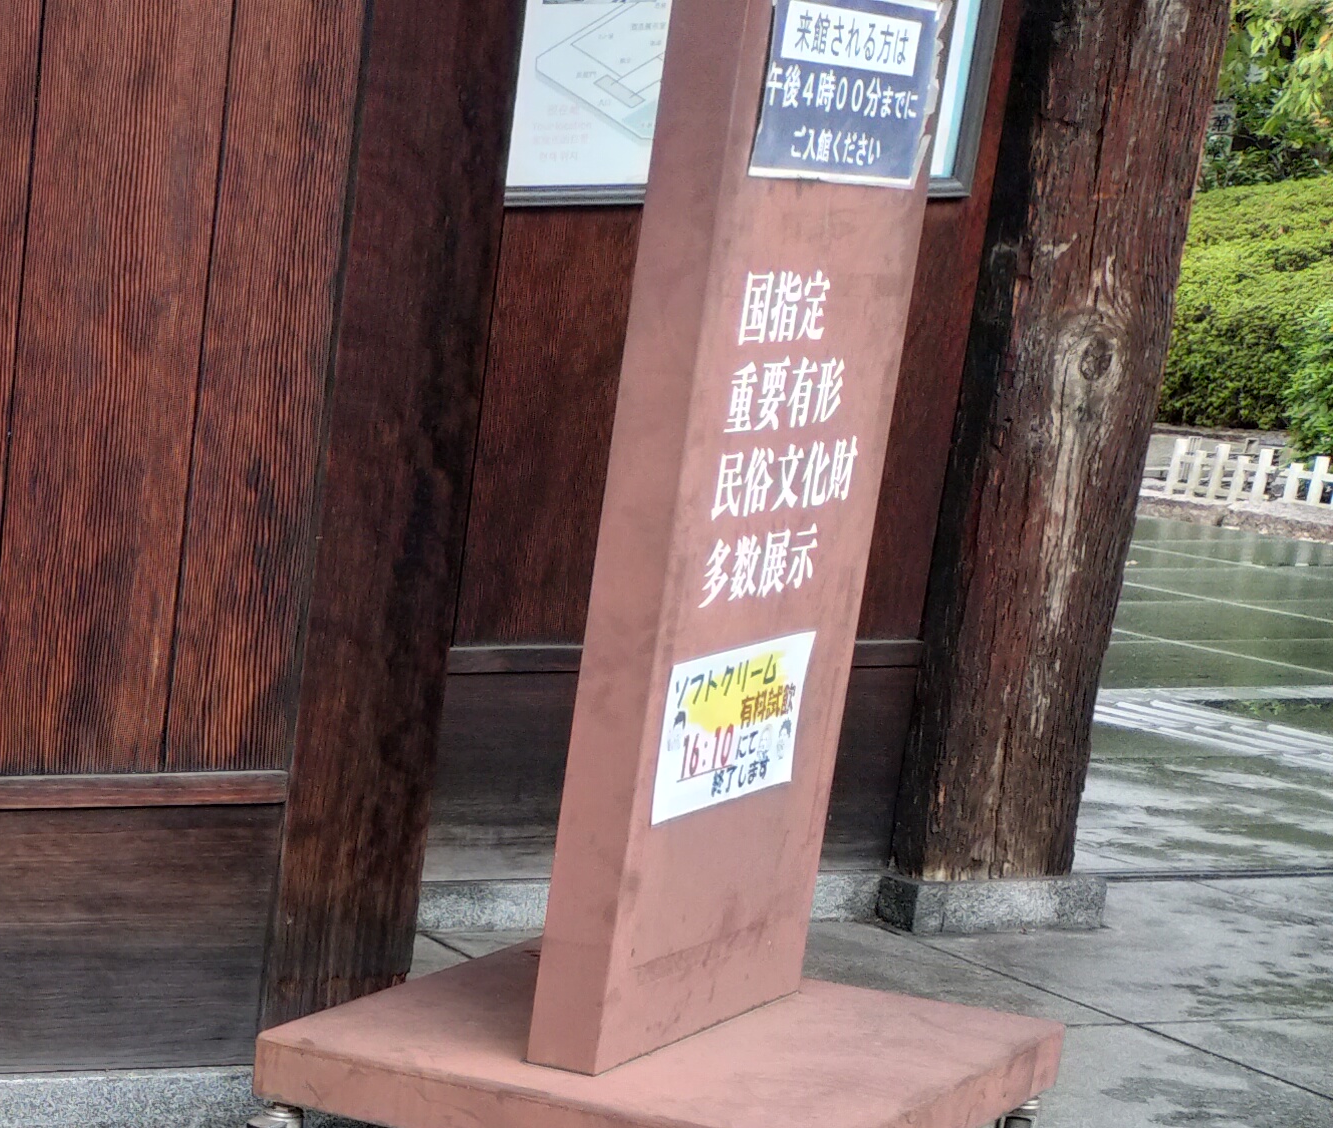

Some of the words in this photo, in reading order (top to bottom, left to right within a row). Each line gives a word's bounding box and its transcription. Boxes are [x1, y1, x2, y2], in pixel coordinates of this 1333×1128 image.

[794, 9, 909, 66] 来館される方は
[790, 124, 881, 167] ご入館ください
[737, 269, 832, 346] 国指定
[723, 354, 846, 434] 重要有形
[710, 435, 859, 521] 民俗文化財
[697, 523, 819, 609] 多数展示
[675, 653, 777, 709] ソフトクリーム
